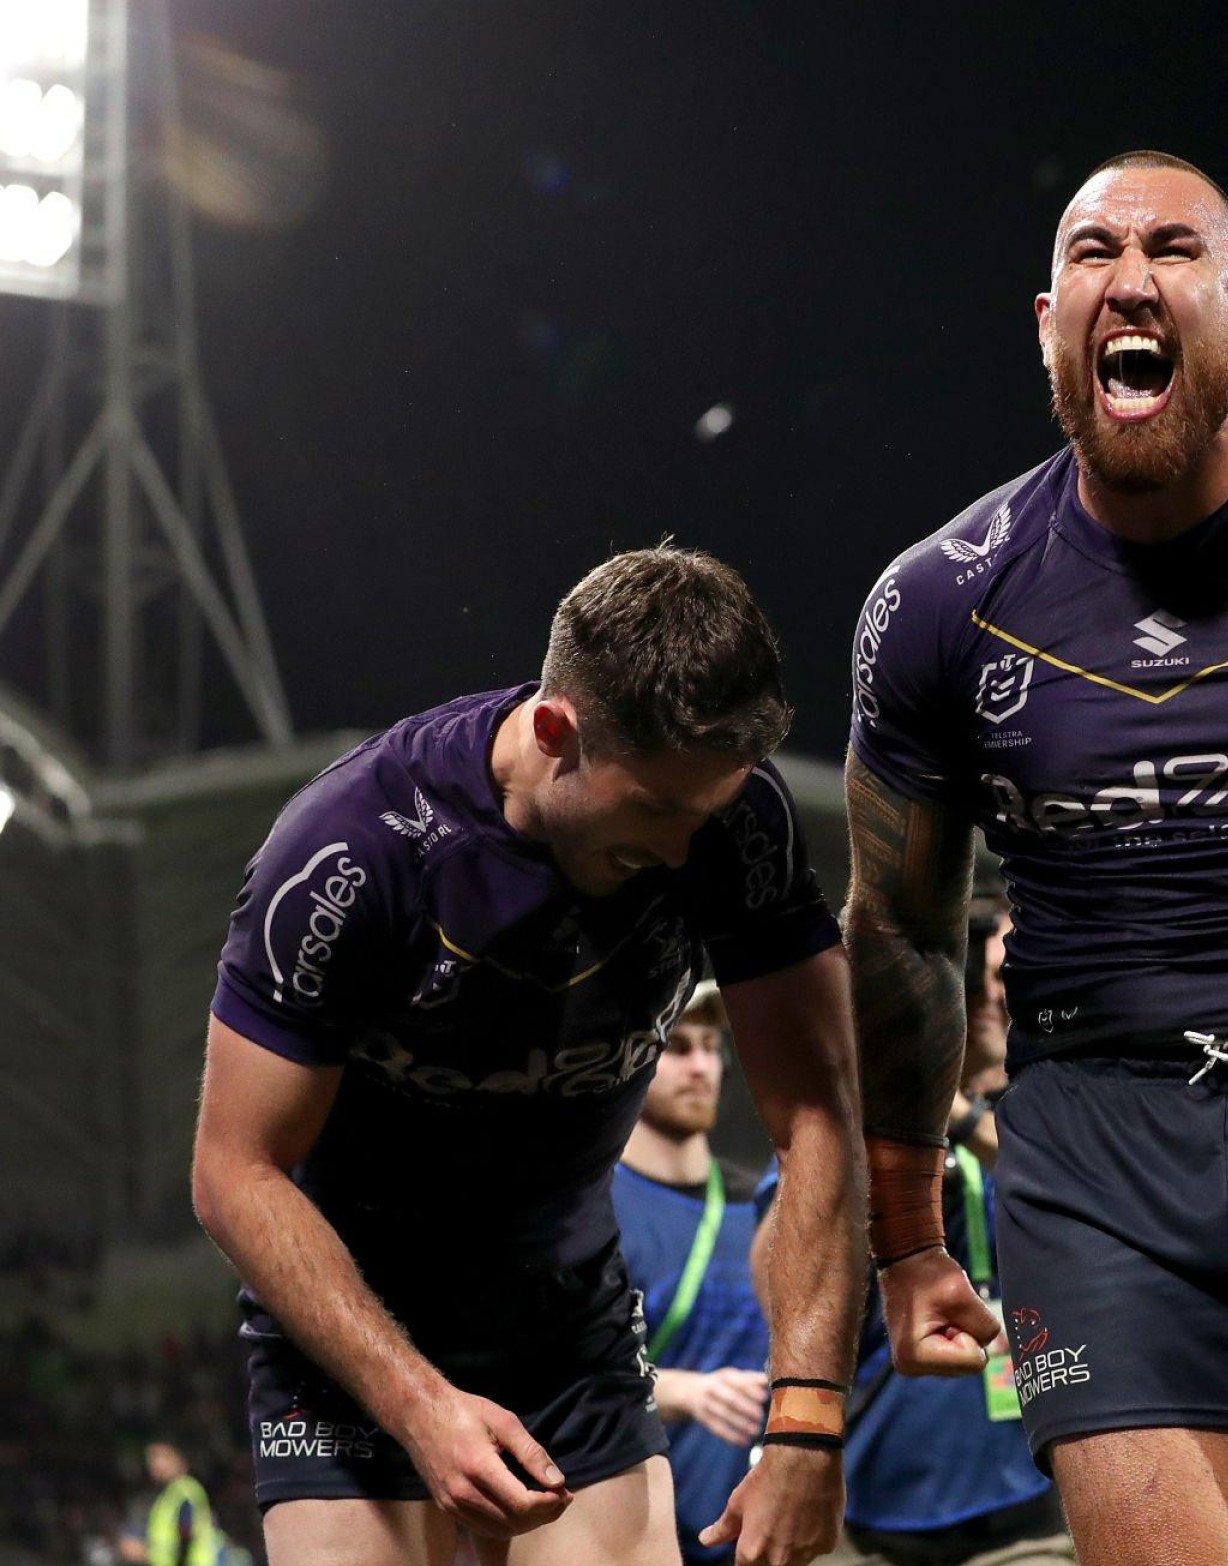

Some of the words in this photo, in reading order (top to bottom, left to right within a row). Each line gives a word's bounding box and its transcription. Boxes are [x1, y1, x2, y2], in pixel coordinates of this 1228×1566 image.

[1130, 657, 1190, 668] SUZUKI
[292, 857, 367, 1000] arsales
[1034, 1344, 1087, 1373] BOY
[260, 1421, 307, 1438] BAD
[314, 1421, 380, 1440] BOY
[260, 1439, 376, 1459] MOWERS
